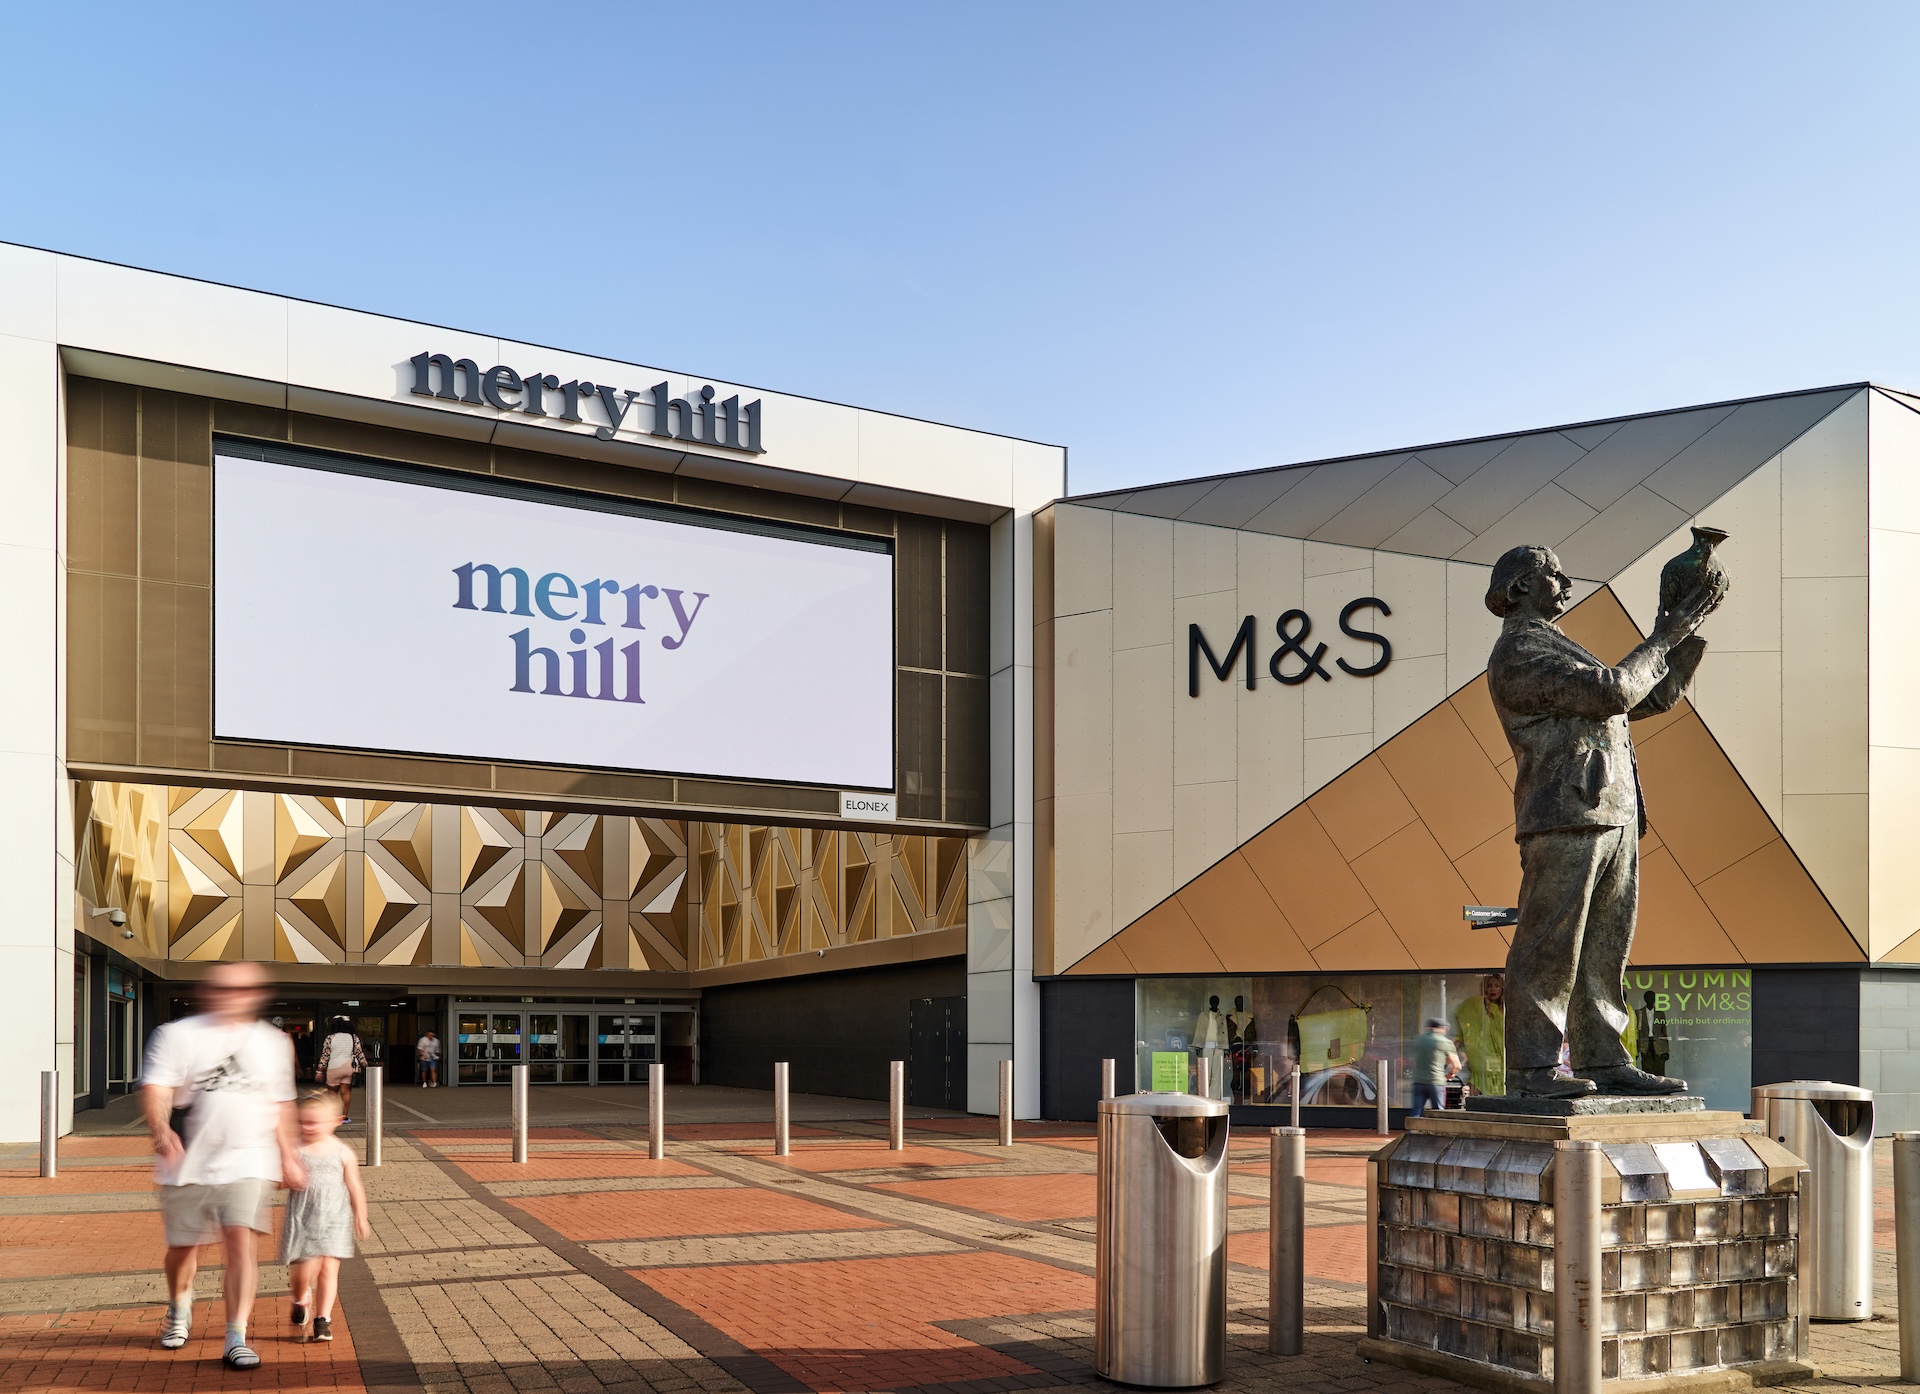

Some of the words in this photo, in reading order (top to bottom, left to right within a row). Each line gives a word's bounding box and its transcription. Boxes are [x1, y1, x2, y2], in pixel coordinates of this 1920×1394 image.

[410, 350, 641, 441] merry
[650, 380, 768, 455] hill
[452, 561, 710, 650] merry
[508, 627, 646, 704] hill
[1189, 596, 1393, 698] M&S
[846, 800, 889, 812] ELONEX
[1654, 1017, 1694, 1026] Anything
[1695, 1017, 1711, 1025] but
[1712, 1017, 1751, 1026] ordinary
[1655, 993, 1692, 1011] BY
[1697, 992, 1751, 1011] M&S
